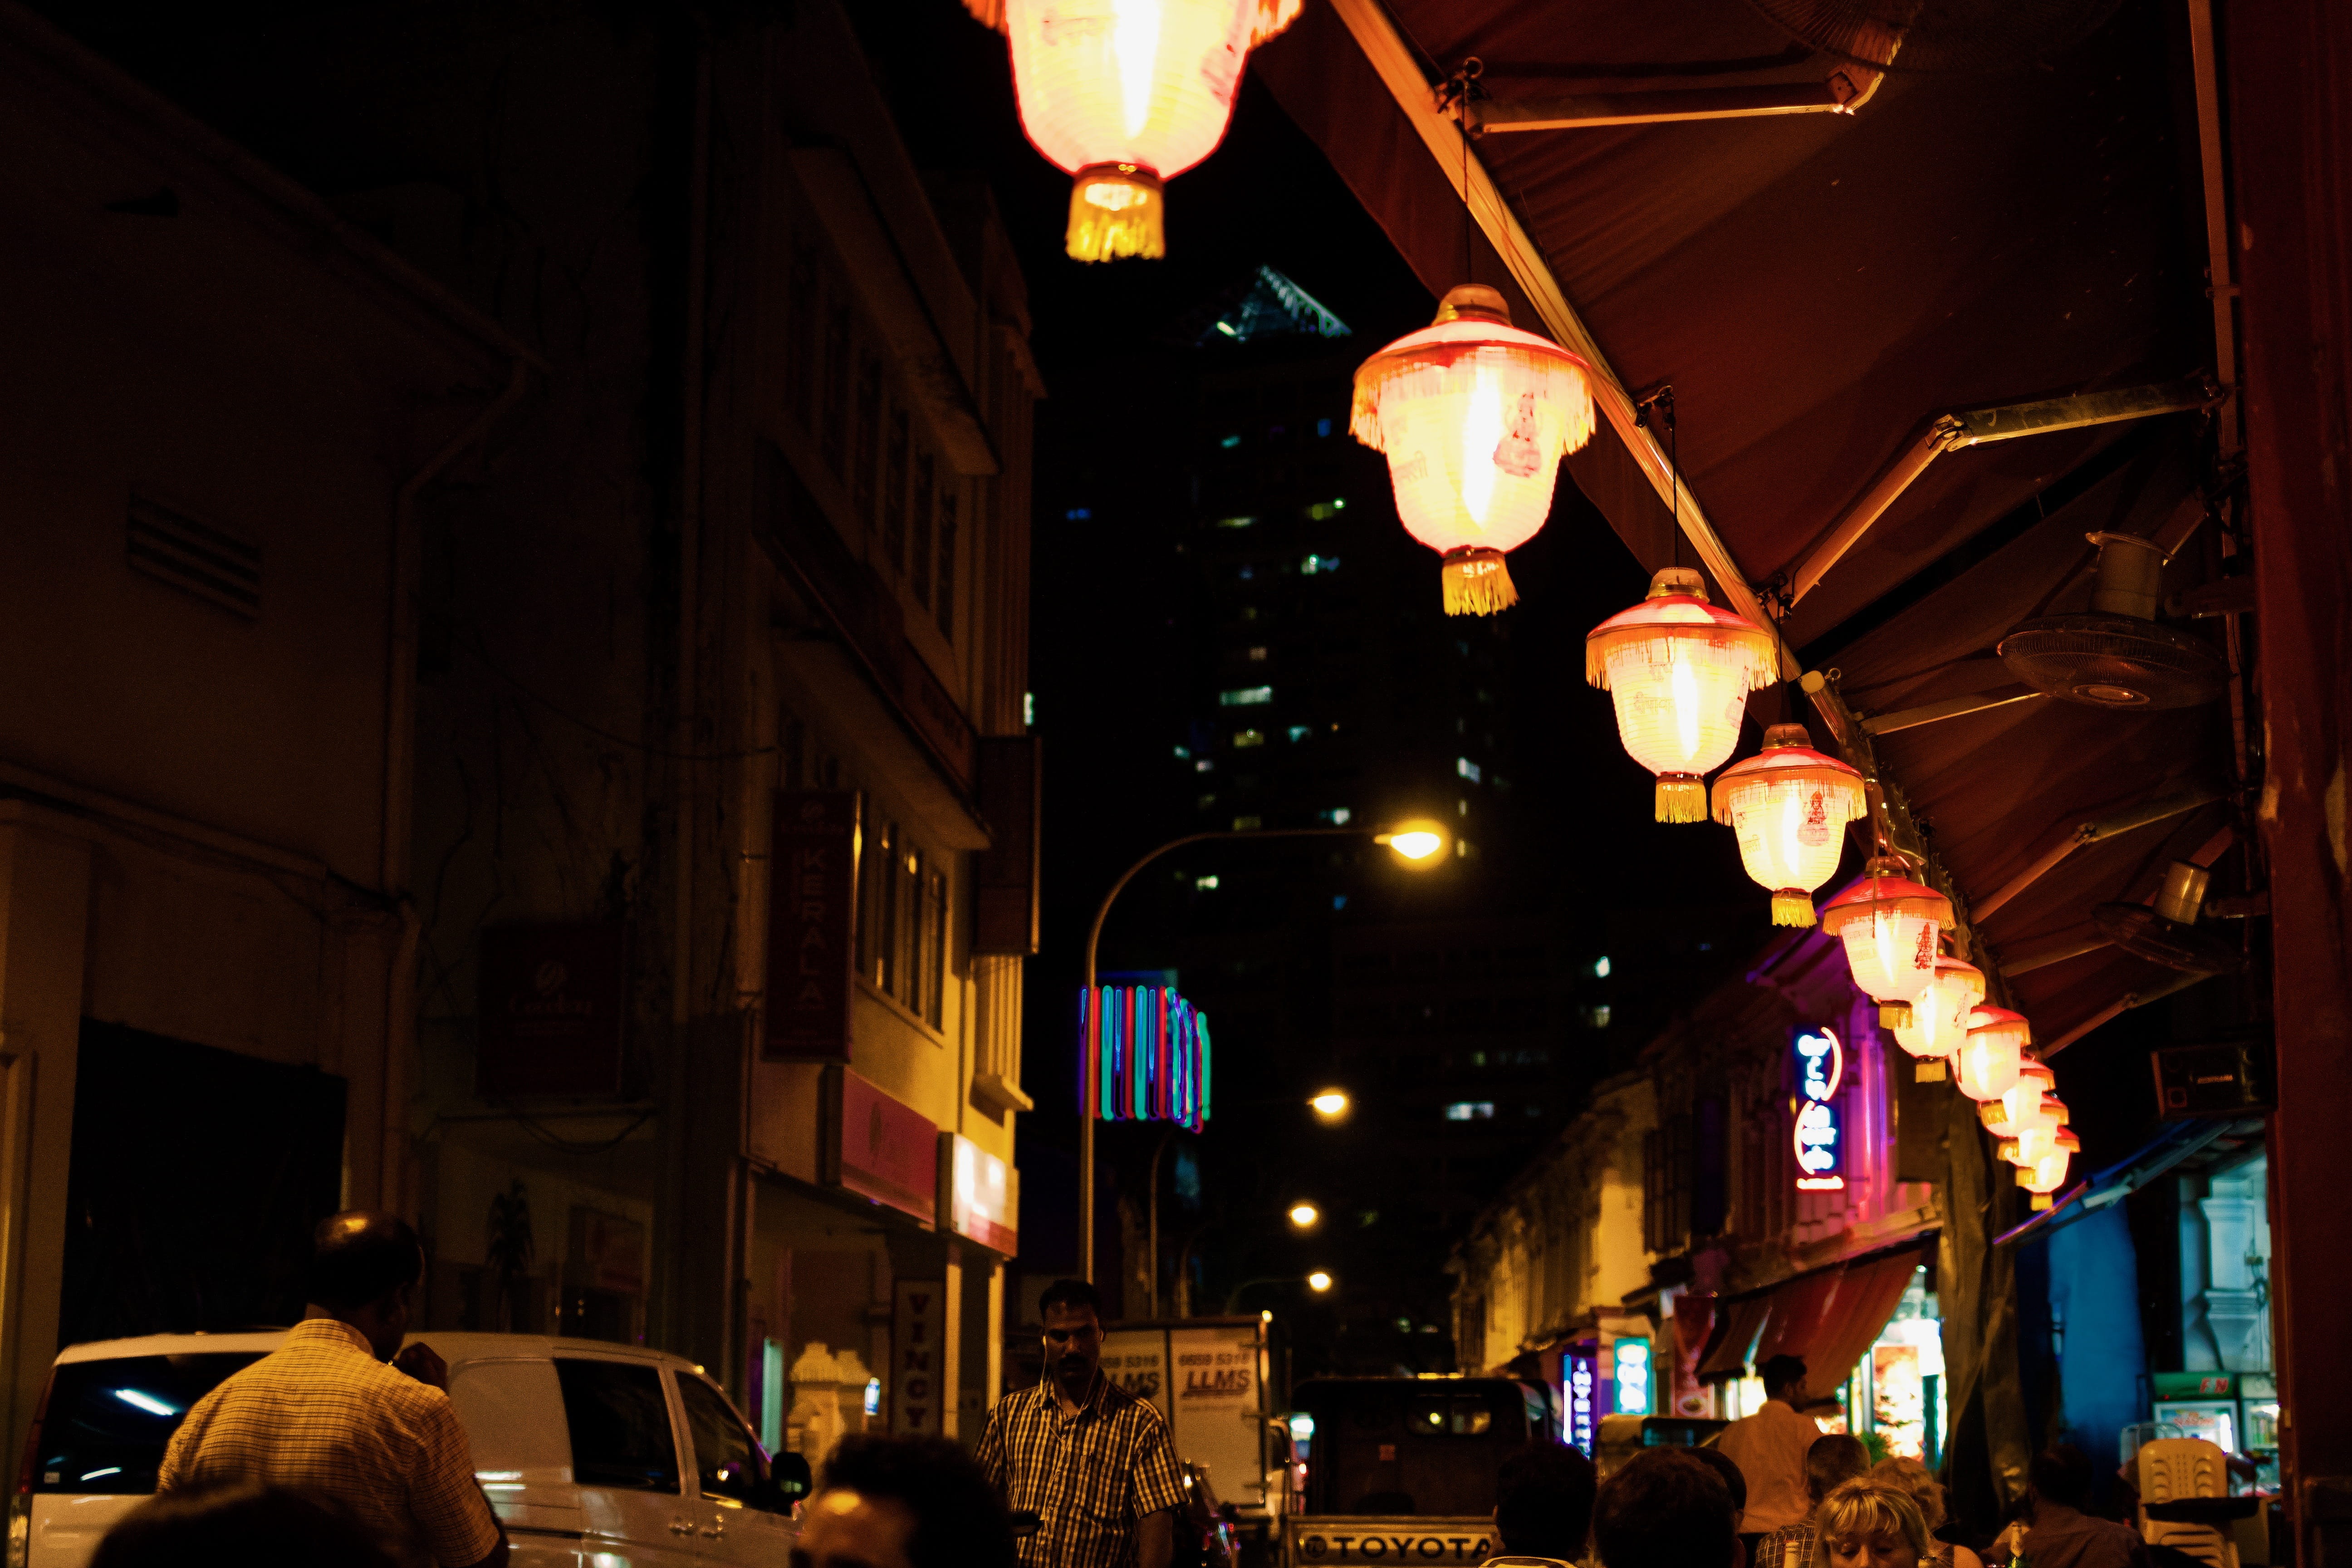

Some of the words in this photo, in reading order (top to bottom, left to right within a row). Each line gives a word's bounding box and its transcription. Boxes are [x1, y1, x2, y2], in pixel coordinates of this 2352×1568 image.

[797, 847, 827, 1002] KERALA
[1186, 1369, 1251, 1391] LLMS
[1332, 1536, 1491, 1559] TOYOTA
